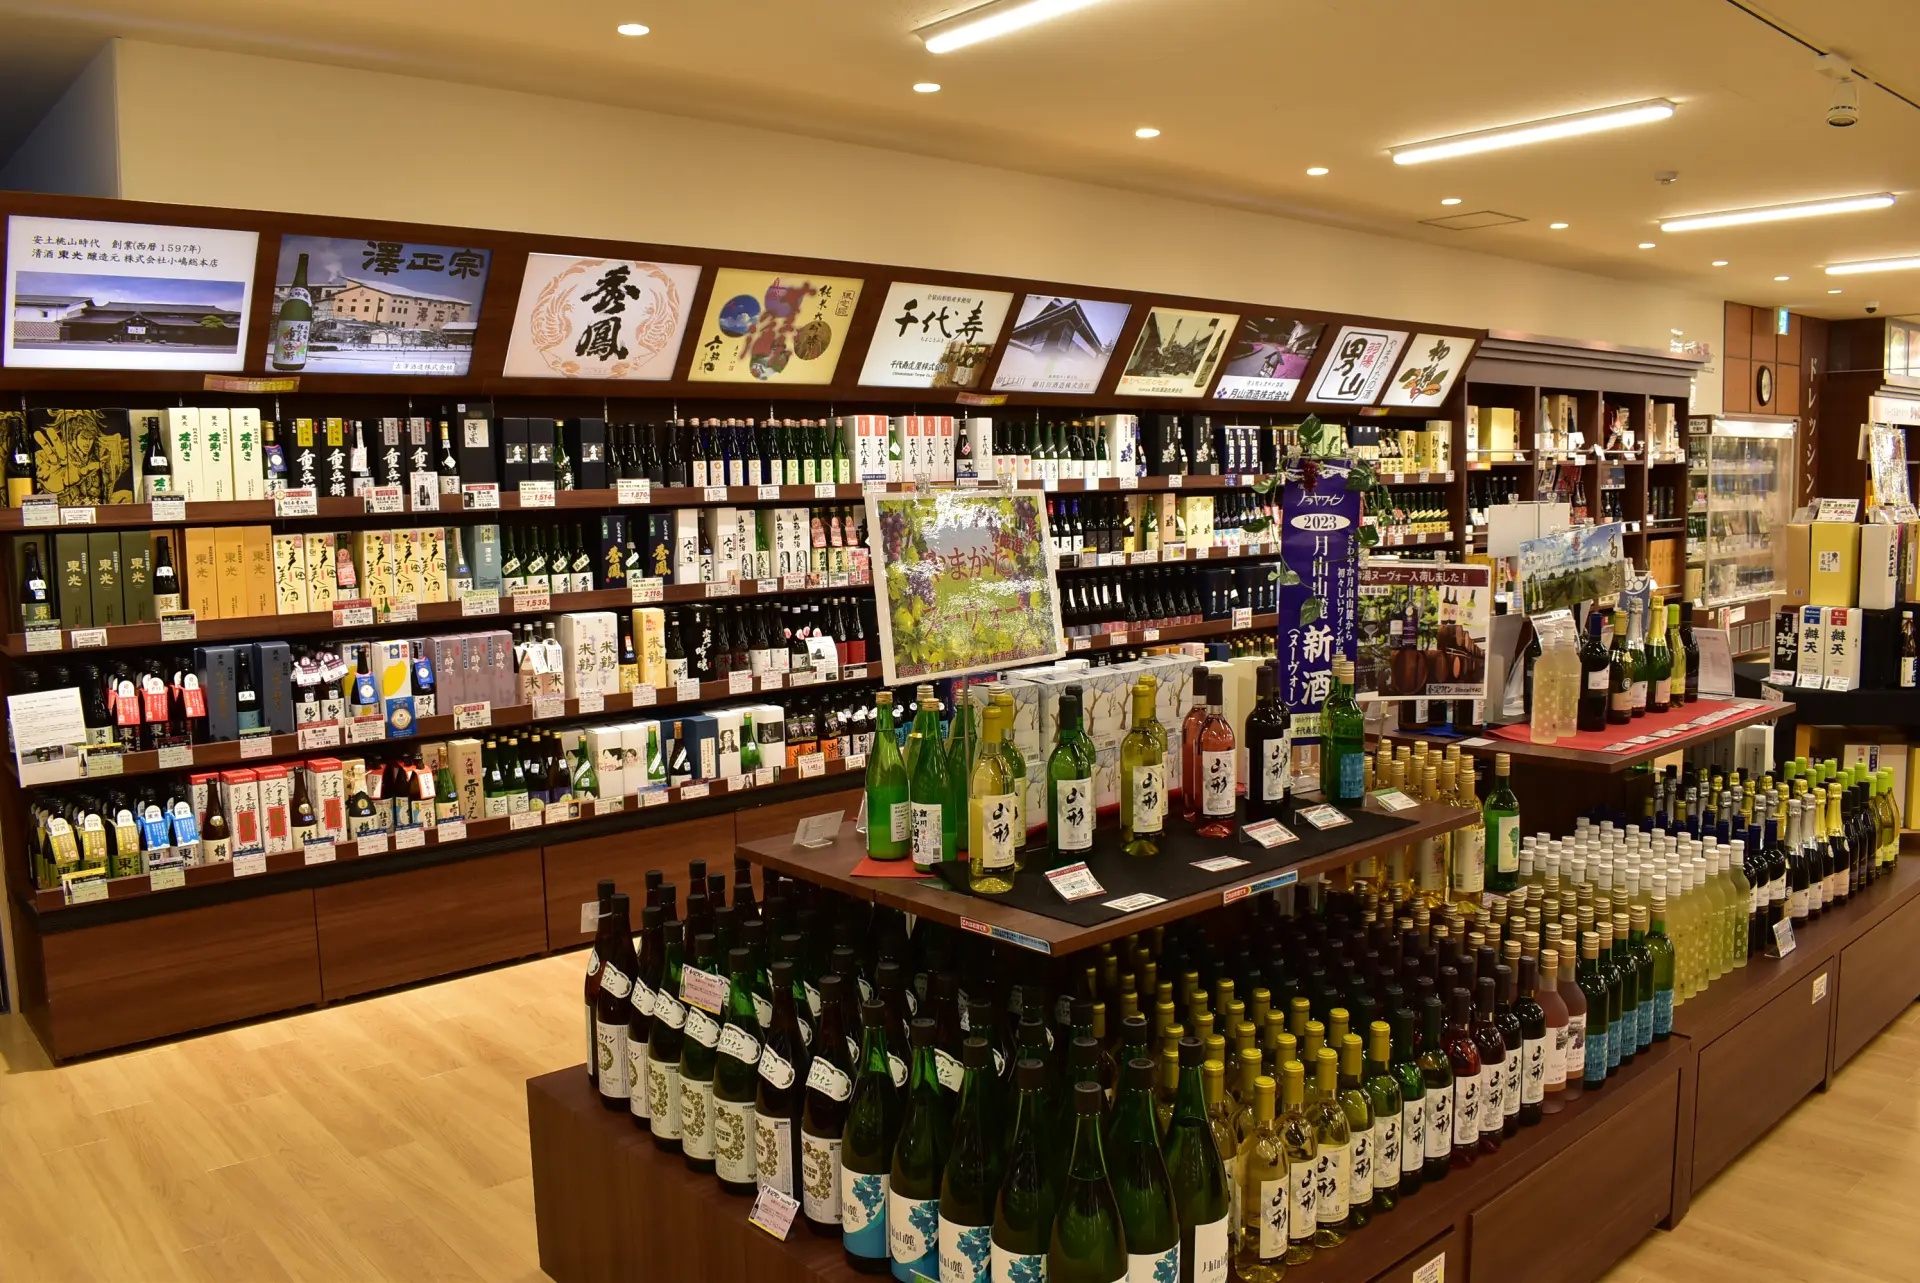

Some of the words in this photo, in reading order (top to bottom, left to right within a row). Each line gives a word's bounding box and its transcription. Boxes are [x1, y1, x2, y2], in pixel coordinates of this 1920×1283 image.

[31, 248, 54, 260] 清酒
[57, 250, 84, 261] 東光
[87, 252, 121, 263] 醸造元
[124, 254, 219, 268] 株式会社小嶋総本店
[32, 235, 100, 249] 安土桃山時代
[112, 240, 157, 252] 創業(西暦
[160, 243, 202, 254] 1597年)
[362, 240, 486, 280] 澤正宗
[575, 262, 642, 362] 秀鳳
[894, 299, 984, 345] 千代寿
[704, 335, 724, 374] 六歌仙
[1333, 337, 1368, 396] 男山
[1229, 387, 1290, 401] 月山酒造株式会社
[860, 438, 870, 468] 千代寿
[878, 438, 887, 468] 千代寿
[909, 438, 919, 467] 千代寿
[926, 438, 936, 467] 千代寿
[943, 438, 952, 467] 千代寿
[326, 448, 347, 497] 重兵衛
[1303, 515, 1338, 530] 2023
[66, 560, 83, 587] 東光
[98, 559, 114, 586] 東光
[130, 557, 146, 584] 東光
[195, 553, 209, 579] 東光
[224, 552, 238, 578] 東光
[252, 550, 267, 576] 東光
[605, 543, 625, 579] 秀鳳
[651, 543, 672, 577] 秀鳳
[578, 642, 596, 672] 米鶴
[599, 640, 617, 671] 米鶴
[647, 635, 664, 665] 米鶴
[1300, 623, 1335, 705] 新酒
[1210, 758, 1228, 796] 山形
[1271, 745, 1284, 781] 山形
[1065, 787, 1085, 828] 山形
[1142, 772, 1158, 811] 山形
[992, 802, 1010, 843] 山形
[1507, 1055, 1521, 1093] 山形
[1531, 1045, 1545, 1081] 山形
[1464, 1082, 1480, 1121] 山形
[1489, 1070, 1504, 1109] 山形
[1412, 1106, 1425, 1147] 山形
[1435, 1094, 1451, 1136] 山形
[1354, 1138, 1372, 1179] 山形
[1384, 1122, 1400, 1163] 山形
[1301, 1169, 1317, 1212] 山形
[1317, 1155, 1337, 1198] 山形
[1271, 1187, 1287, 1231] 山形
